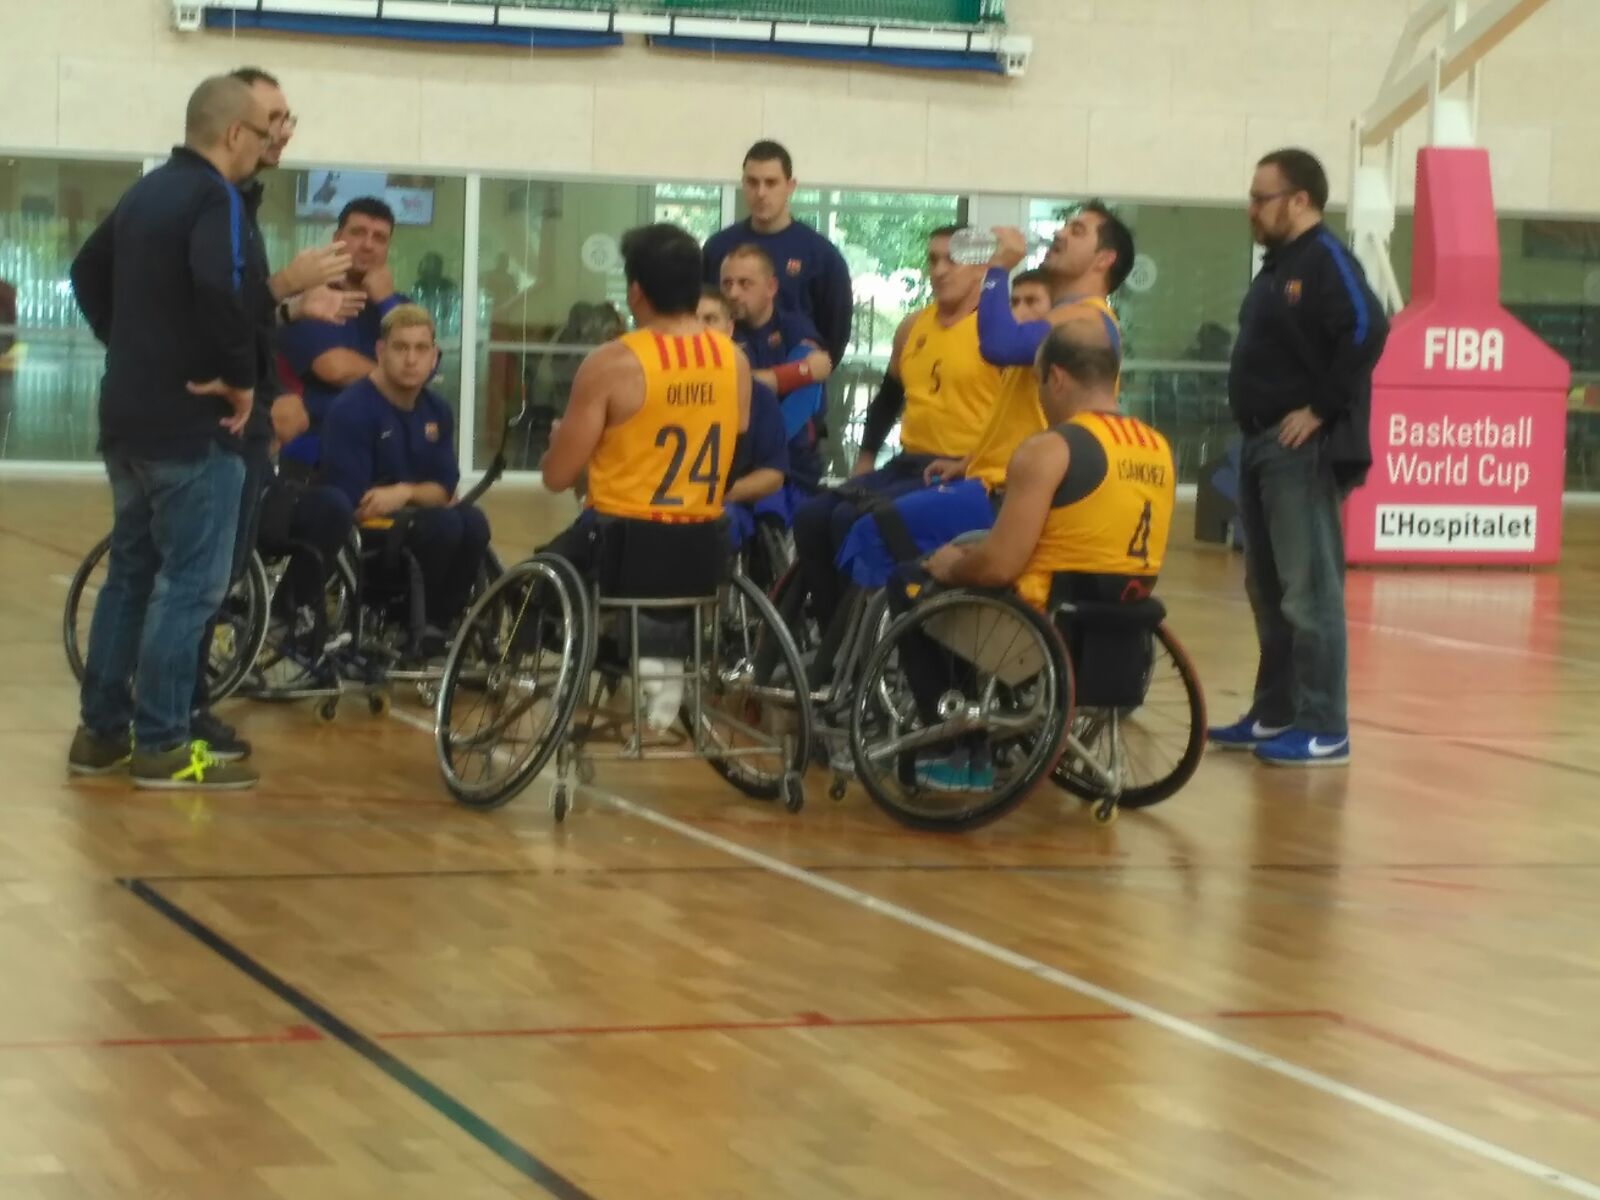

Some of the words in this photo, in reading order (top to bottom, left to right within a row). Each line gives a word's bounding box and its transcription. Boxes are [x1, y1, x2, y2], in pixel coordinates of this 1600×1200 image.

[1424, 327, 1504, 371] FIBA
[928, 358, 942, 395] 5
[1388, 413, 1533, 448] Basketball
[650, 421, 722, 506] 24
[1386, 453, 1468, 485] World
[1478, 454, 1530, 493] Cup
[1127, 499, 1152, 569] 4
[1380, 511, 1533, 542] L'Hospitalet
